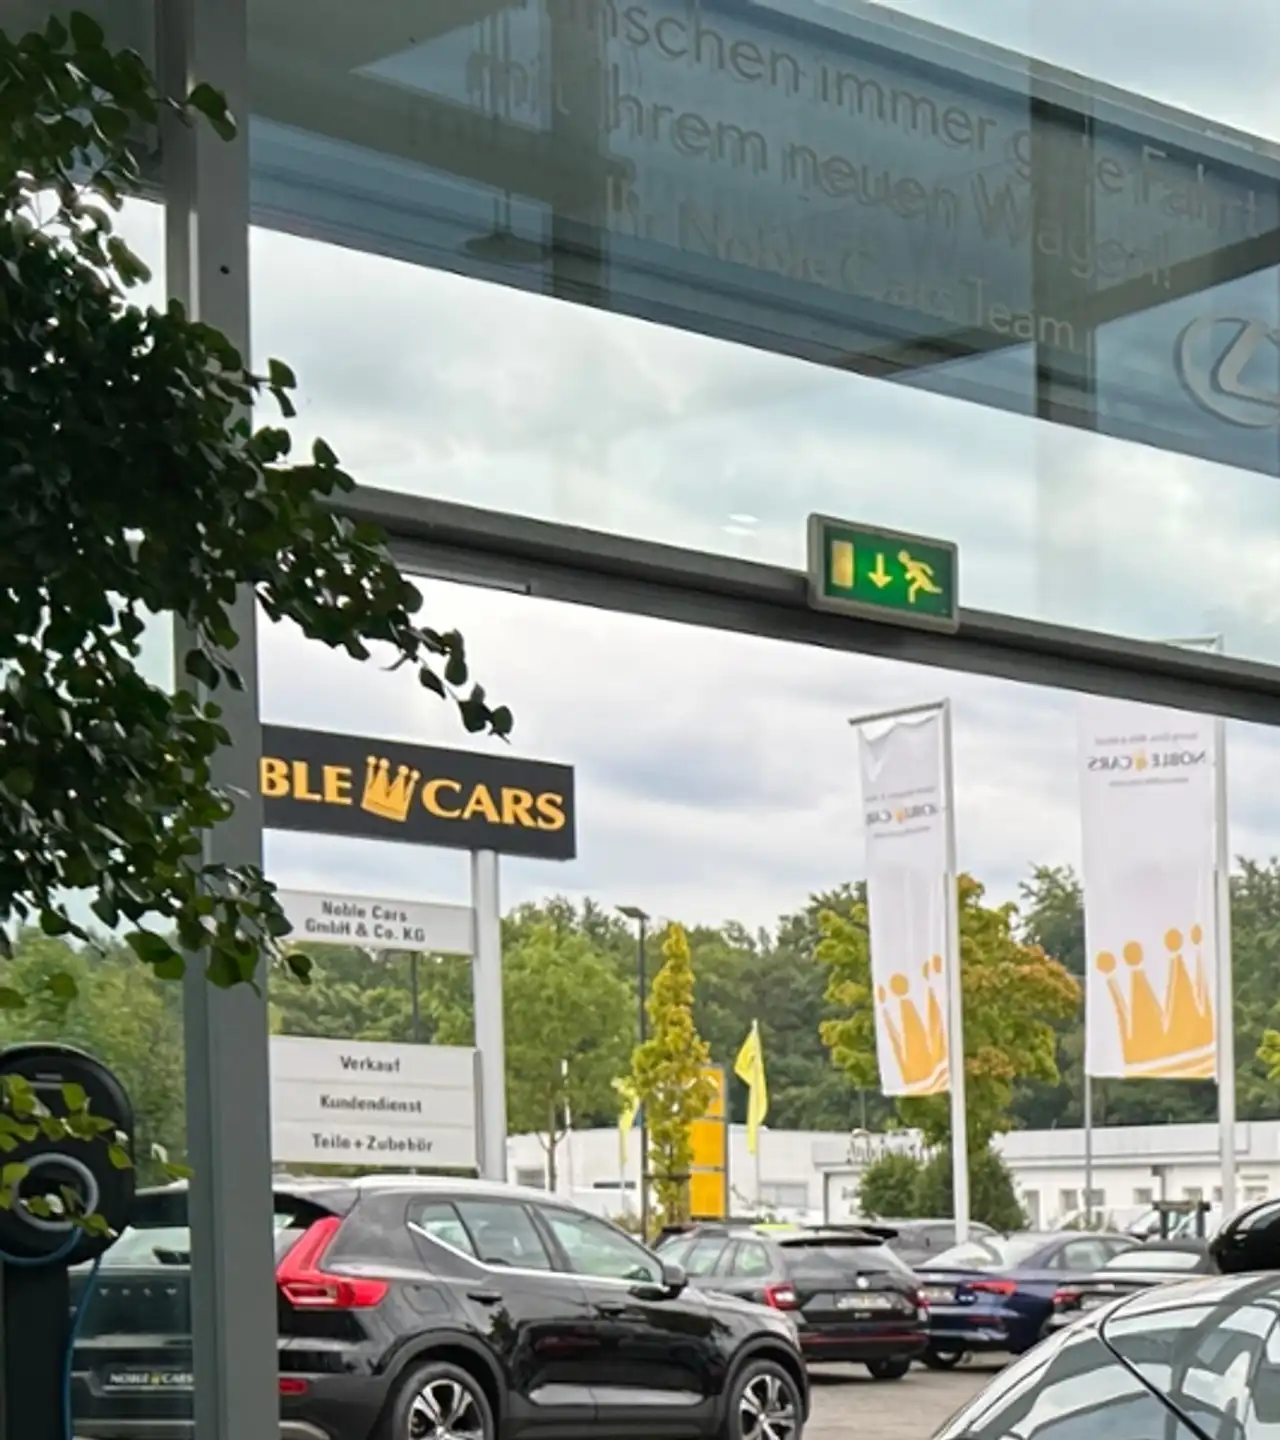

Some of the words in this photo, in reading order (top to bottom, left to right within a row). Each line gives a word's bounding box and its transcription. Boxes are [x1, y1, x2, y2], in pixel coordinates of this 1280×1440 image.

[814, 64, 996, 152] immer
[602, 62, 767, 172] hrem
[781, 139, 957, 228] neuen
[958, 276, 1077, 352] Team
[420, 777, 567, 831] CARS
[305, 917, 350, 935] GmbH
[355, 921, 368, 938] &
[374, 923, 399, 941] Co.
[403, 926, 426, 943] KG
[321, 900, 366, 918] Noble
[372, 904, 408, 922] Cars
[339, 1055, 400, 1073] Verkauf
[319, 1093, 422, 1114] Kundendienst
